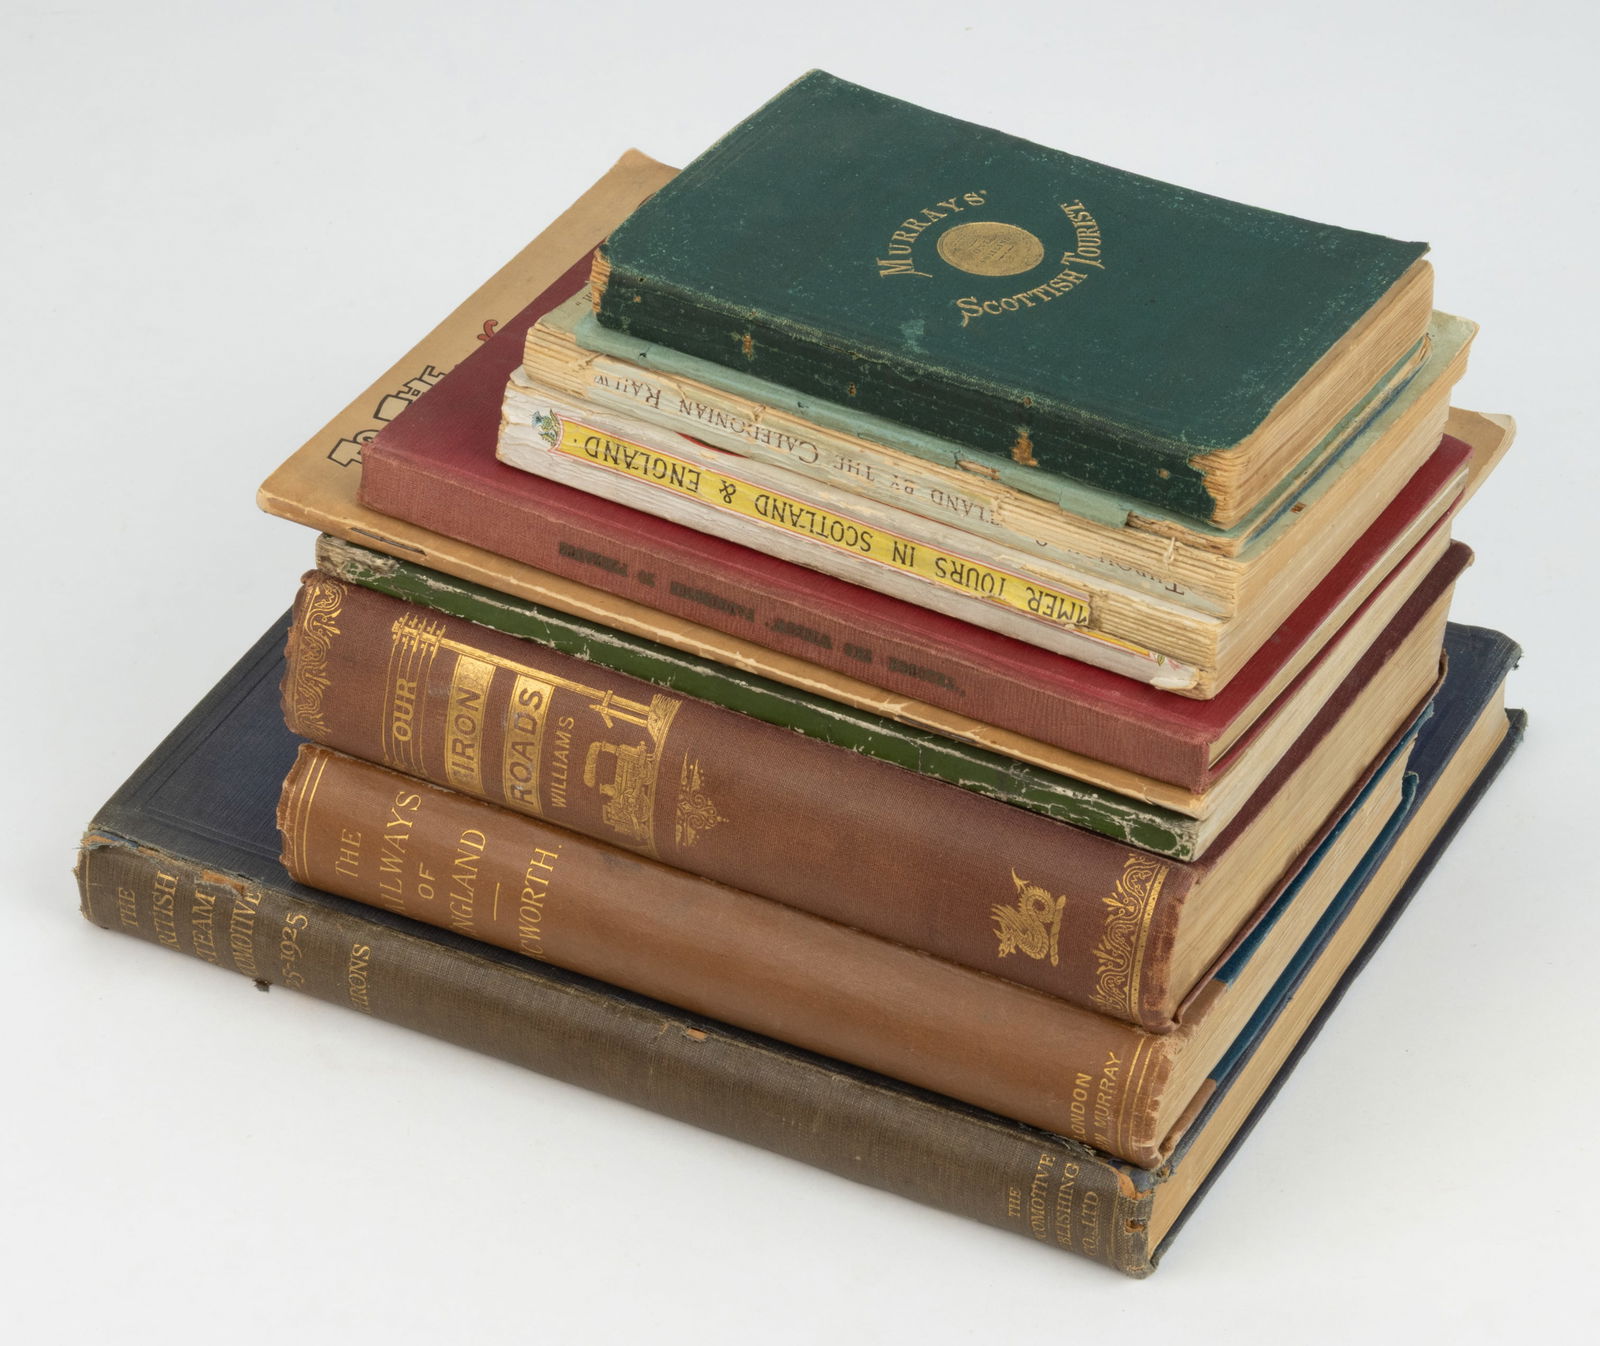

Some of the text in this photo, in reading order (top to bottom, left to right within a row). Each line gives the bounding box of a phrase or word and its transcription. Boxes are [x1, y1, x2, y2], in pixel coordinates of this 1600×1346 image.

[956, 268, 1088, 328] SCOTTISH
[718, 478, 737, 505] &
[754, 493, 874, 553] SCOTLAND
[892, 541, 917, 568] IN
[393, 677, 417, 742] OUR
[451, 686, 482, 779] IRON
[508, 687, 544, 806] ROADS
[551, 715, 575, 808] WILLIAMS
[335, 828, 362, 878] THE
[417, 861, 436, 900] OF
[448, 828, 487, 935] NGLAND
[118, 886, 139, 929] THE
[151, 869, 181, 951] RITISH
[191, 887, 218, 964] TEAM
[518, 844, 563, 960] CWORTH.
[1093, 1051, 1122, 1130] MURRAY
[1008, 1185, 1022, 1217] THE
